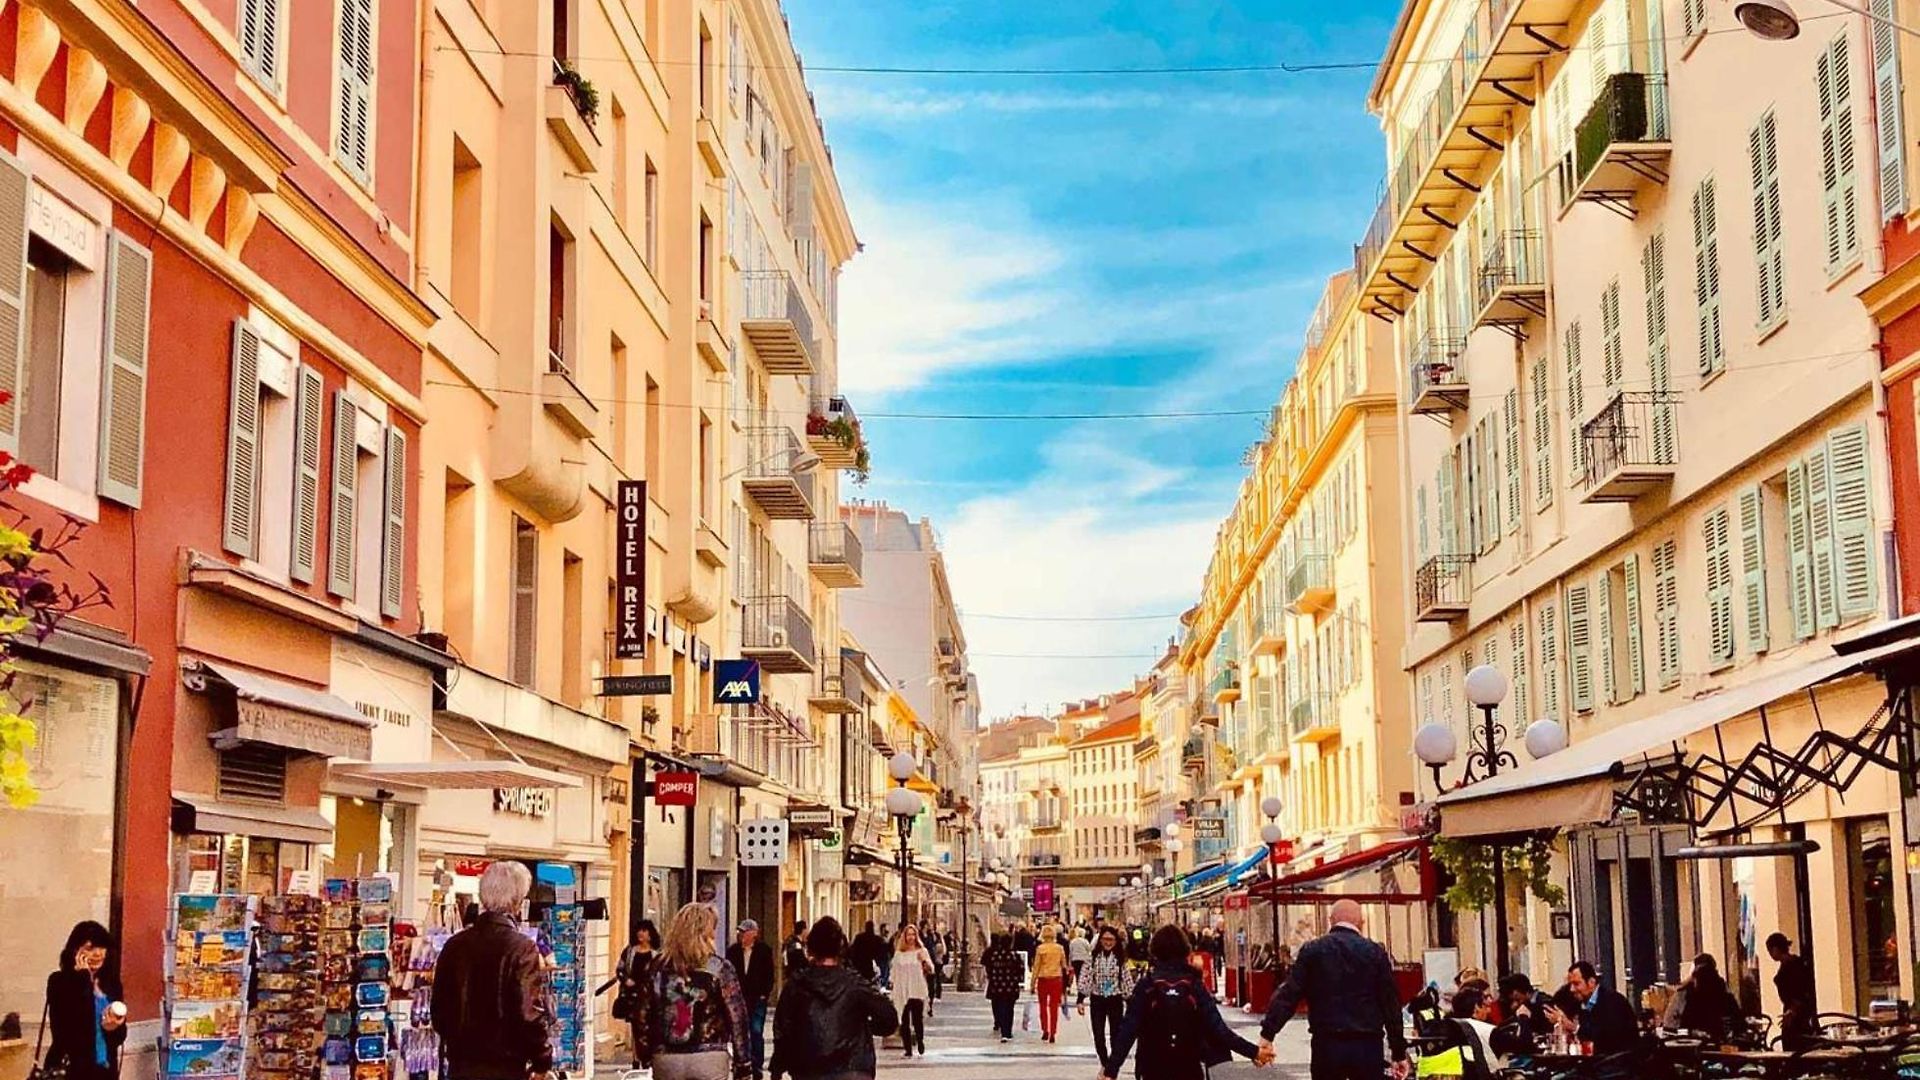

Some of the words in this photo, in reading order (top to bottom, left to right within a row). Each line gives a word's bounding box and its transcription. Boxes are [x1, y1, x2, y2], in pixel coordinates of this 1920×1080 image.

[31, 185, 87, 251] Heyraud
[623, 487, 638, 576] HOTEL
[623, 586, 638, 639] REX
[718, 680, 753, 698] AXA
[658, 782, 694, 795] CAMPER
[747, 852, 779, 860] SIX
